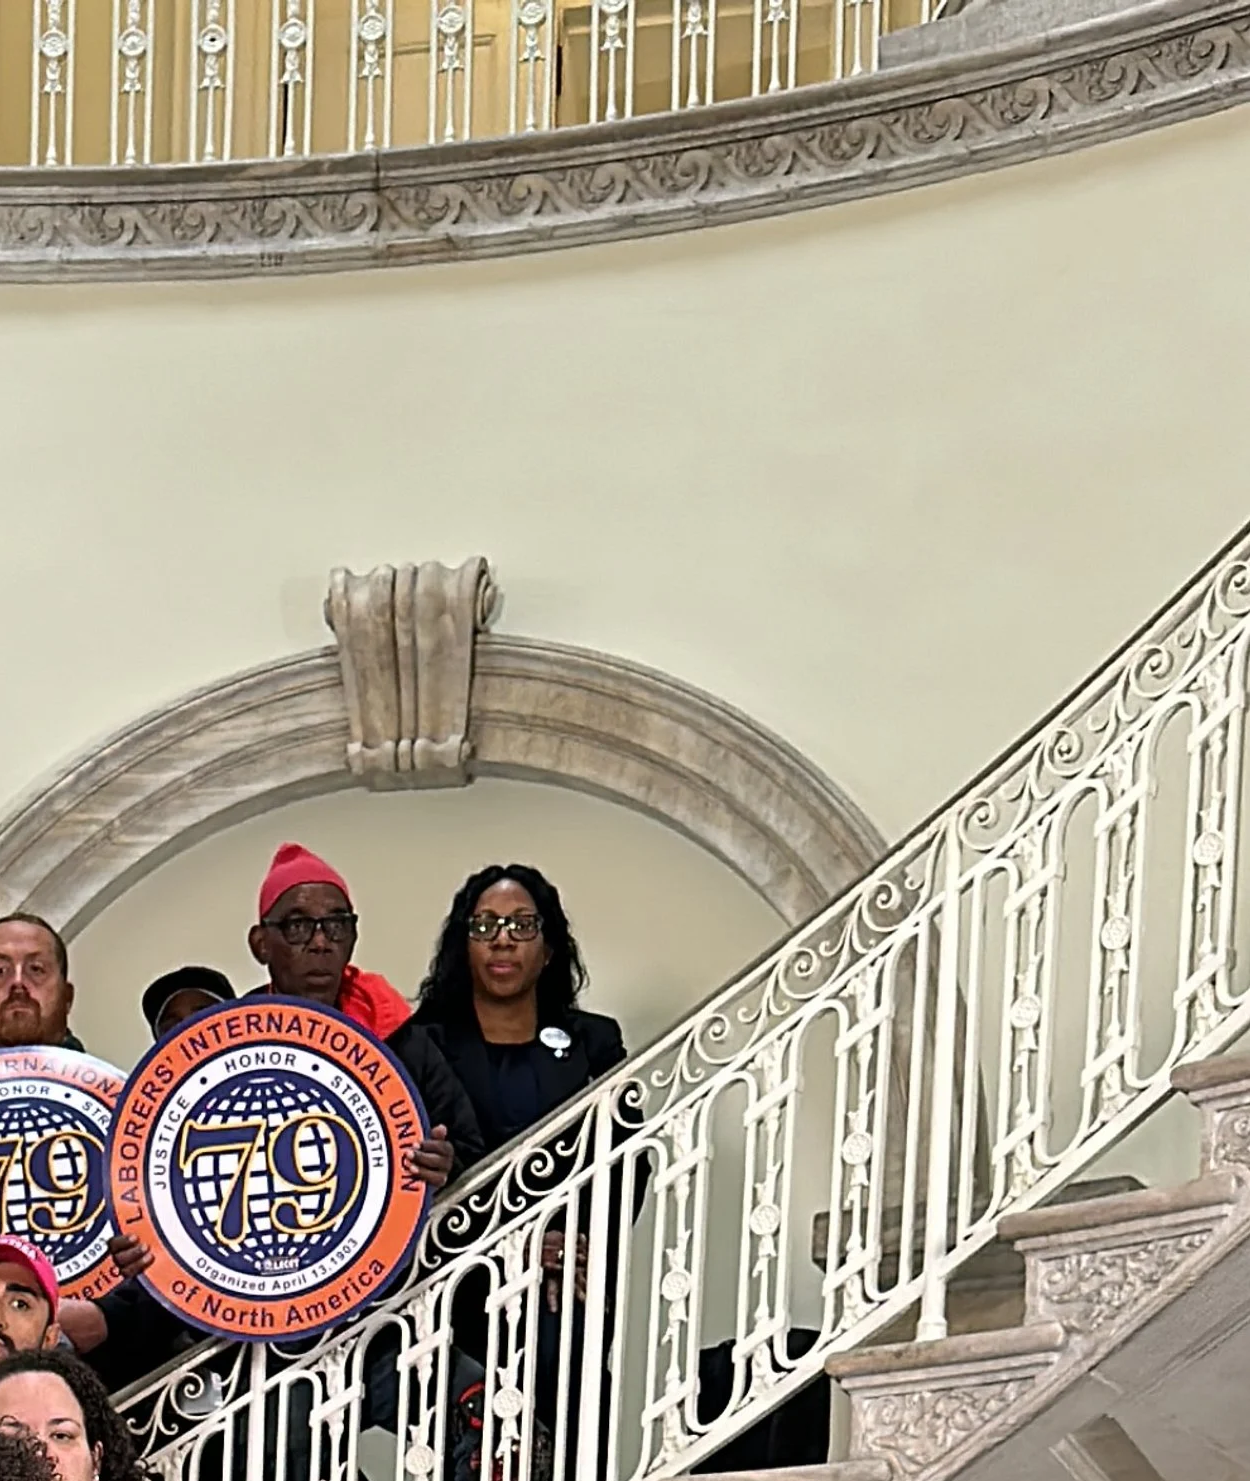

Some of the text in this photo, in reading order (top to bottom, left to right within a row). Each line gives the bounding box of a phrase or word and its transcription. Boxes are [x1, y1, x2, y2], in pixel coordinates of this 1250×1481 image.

[224, 1051, 296, 1073] HONOR
[118, 1056, 174, 1225] LABORERS'
[180, 1012, 391, 1096] INTERNATIONAL
[153, 1095, 190, 1190] JUSTICE
[330, 1075, 384, 1168] STRENGTH
[179, 1111, 364, 1246] 79
[171, 1279, 199, 1302] of
[201, 1294, 274, 1328] North
[285, 1258, 386, 1328] America
[196, 1257, 266, 1291] Organized
[272, 1273, 307, 1292] April
